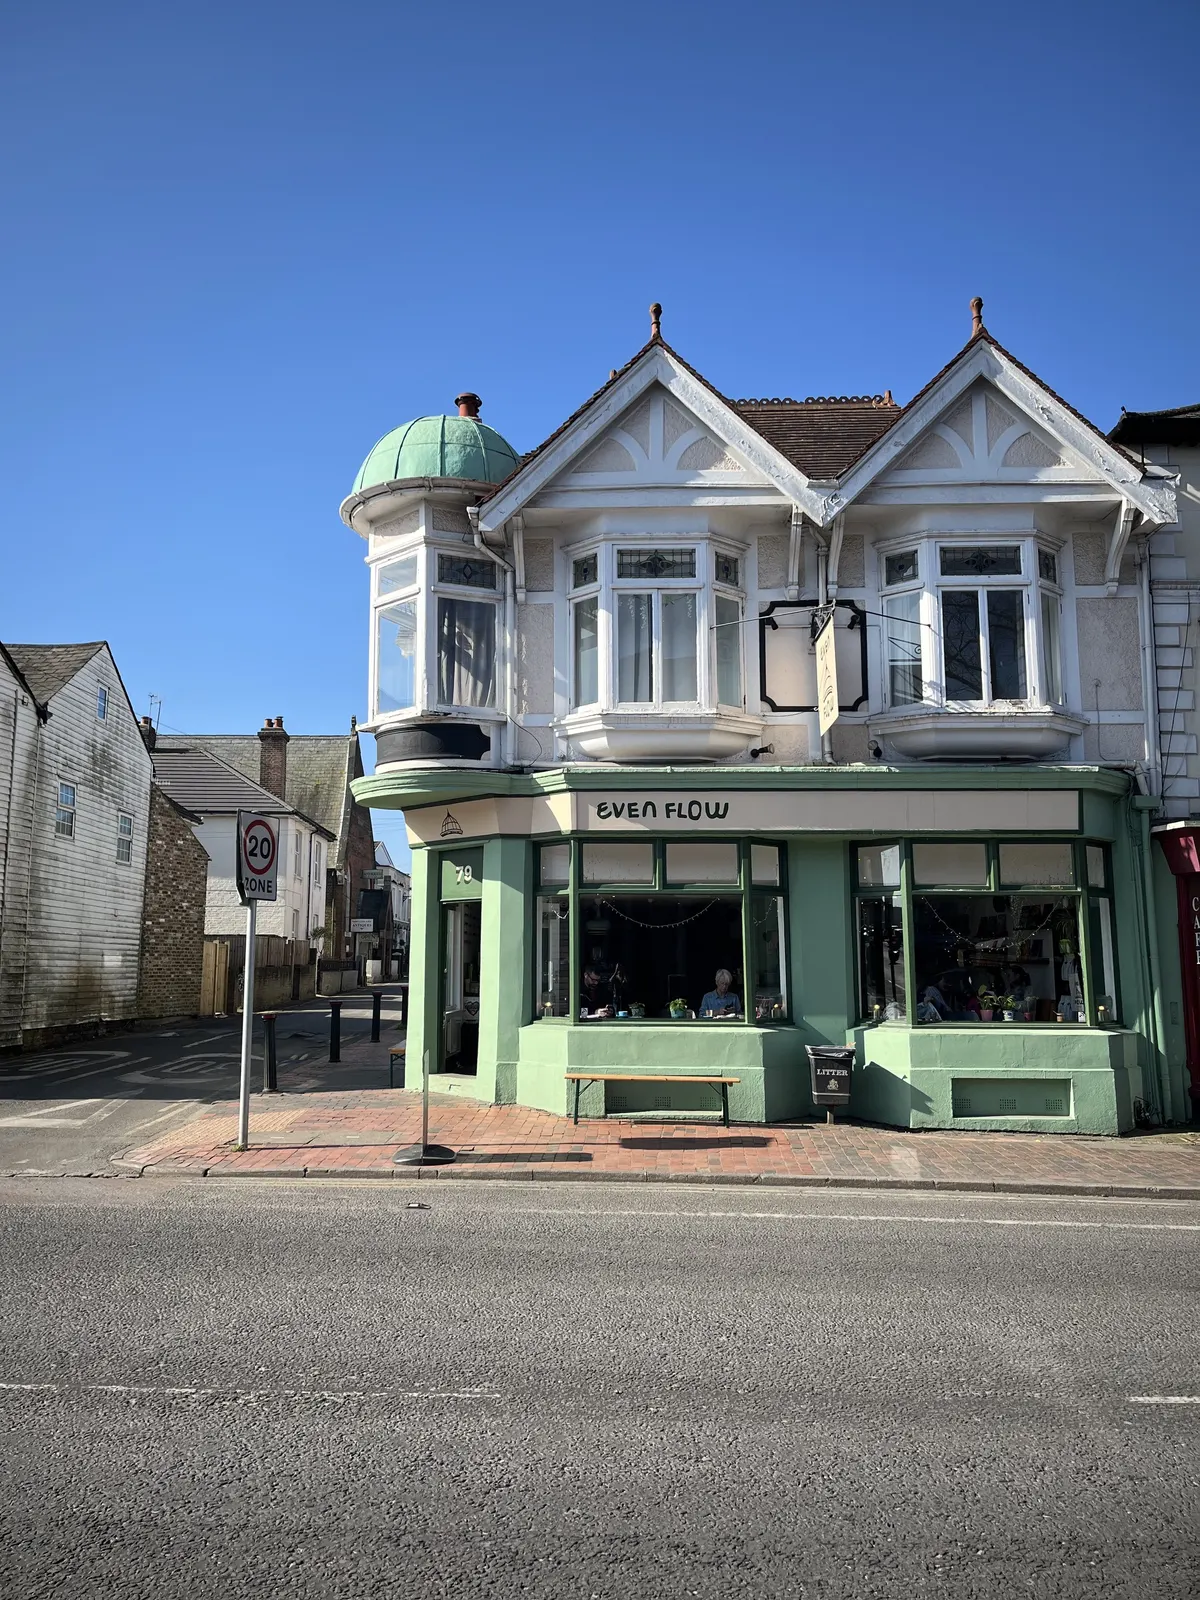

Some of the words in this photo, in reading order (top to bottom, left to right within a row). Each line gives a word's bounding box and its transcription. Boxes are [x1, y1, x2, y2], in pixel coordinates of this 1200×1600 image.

[597, 801, 657, 820] EVEN
[665, 800, 728, 820] FLOW
[248, 835, 271, 860] 20
[244, 877, 273, 893] ZONE
[455, 865, 472, 885] 79
